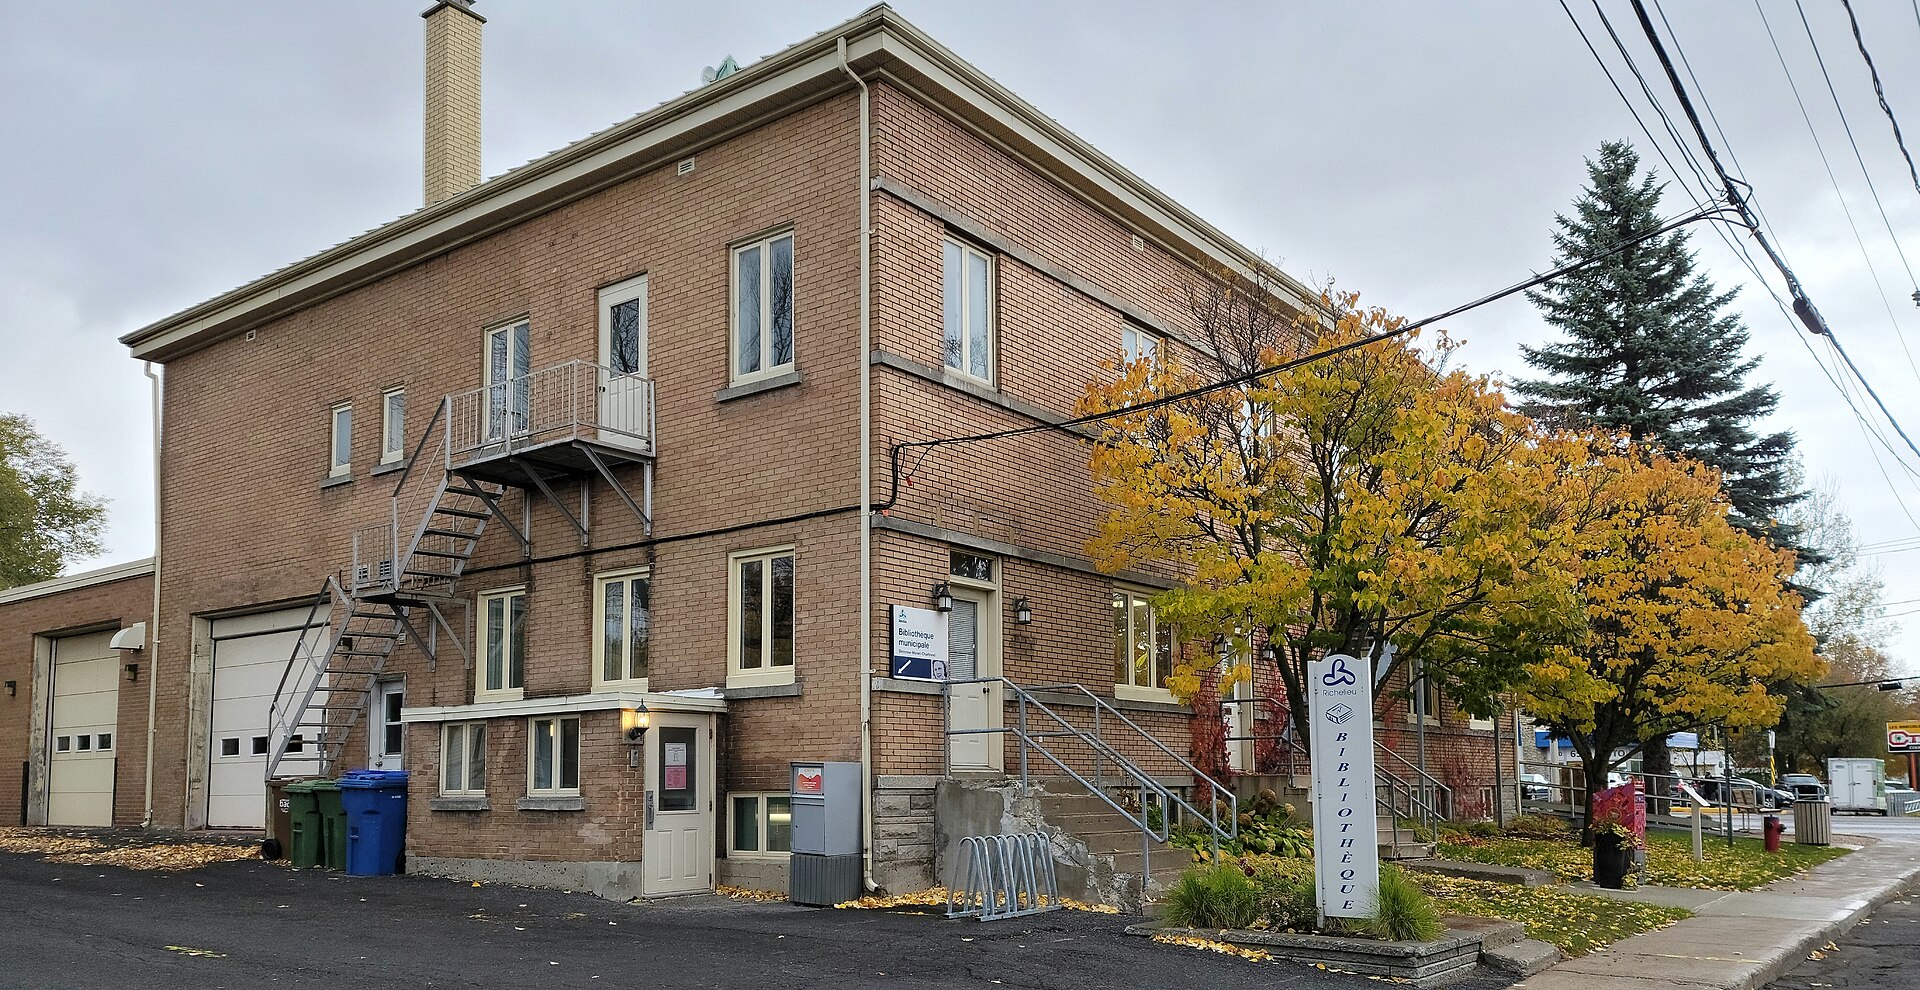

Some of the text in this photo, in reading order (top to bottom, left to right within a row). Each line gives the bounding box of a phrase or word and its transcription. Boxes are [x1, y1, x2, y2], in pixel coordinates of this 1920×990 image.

[899, 628, 934, 640] Bibliothèque
[899, 640, 930, 649] municipale
[1322, 688, 1357, 697] Richelieu
[1336, 731, 1355, 911] BIBLIOTHÈQUE
